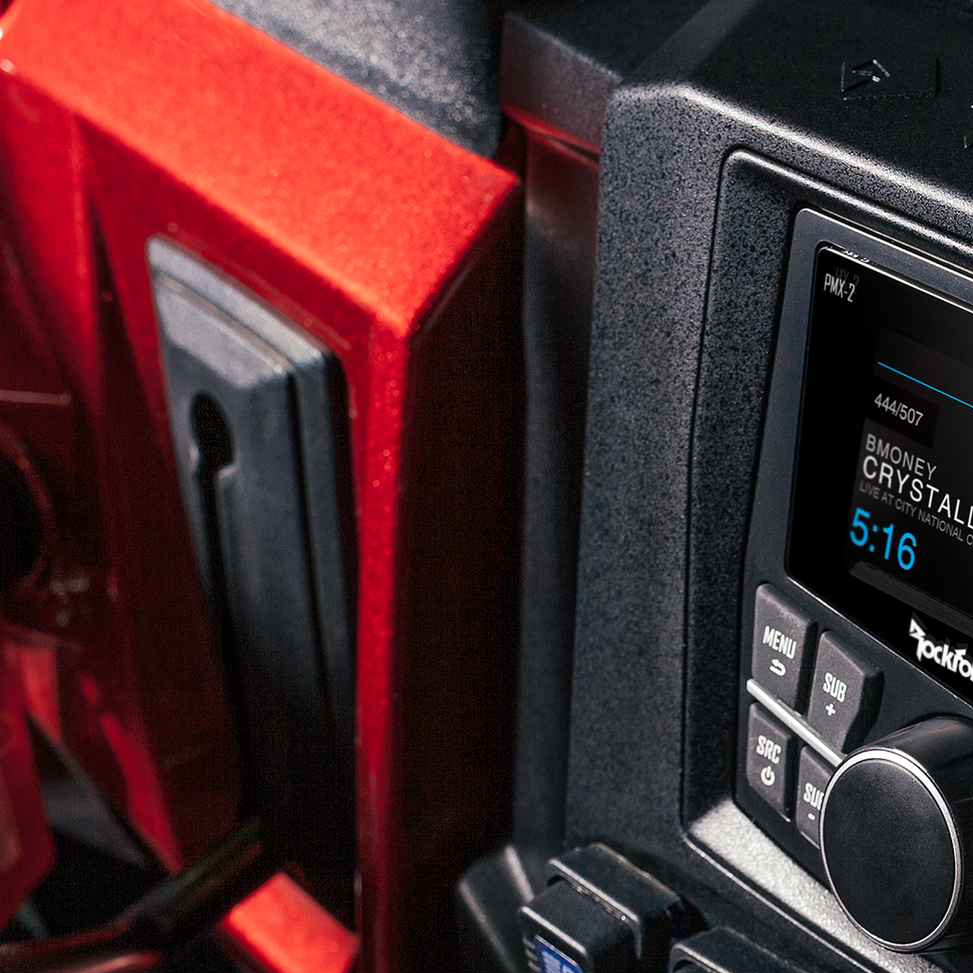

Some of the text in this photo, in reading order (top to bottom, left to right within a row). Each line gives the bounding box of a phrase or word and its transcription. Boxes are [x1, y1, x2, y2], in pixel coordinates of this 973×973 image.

[823, 273, 856, 303] PMX-2
[874, 392, 924, 427] 444/507
[865, 433, 937, 481] BMONEY
[859, 479, 881, 500] LIVE
[881, 491, 895, 507] AT
[895, 497, 918, 518] CITY
[917, 508, 965, 543] NATIONAL
[849, 506, 918, 571] 5:16
[762, 625, 797, 660] MENU
[822, 672, 847, 703] SUB
[756, 735, 782, 765] SRC
